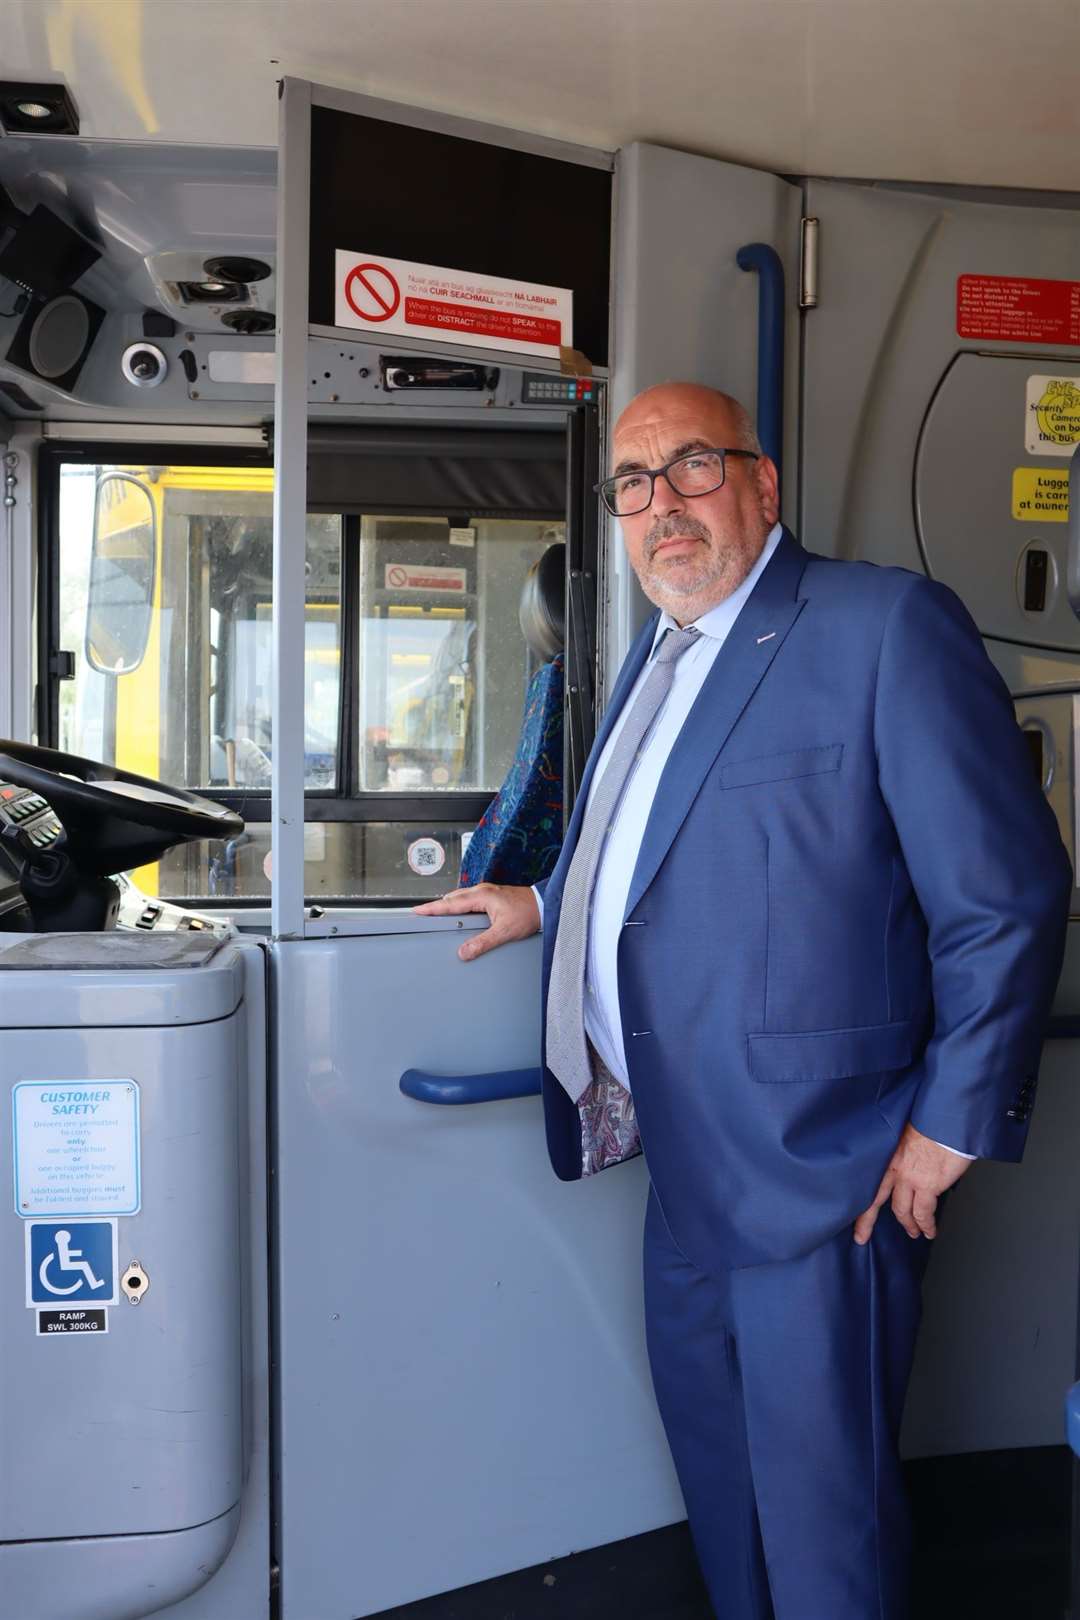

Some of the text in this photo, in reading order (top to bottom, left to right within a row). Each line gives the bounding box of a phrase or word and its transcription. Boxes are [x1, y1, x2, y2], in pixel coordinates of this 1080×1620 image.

[430, 287, 448, 296] CUIR
[450, 290, 495, 304] SEACHMALL
[408, 301, 429, 312] When
[443, 306, 456, 316] bus
[512, 318, 536, 328] SPEAK
[408, 310, 427, 319] driver
[438, 315, 475, 326] DISTRACT
[1030, 403, 1063, 414] Security
[1039, 432, 1074, 442] this bus
[1038, 477, 1069, 488] Lugga
[1035, 490, 1069, 500] is carr
[1020, 500, 1069, 511] at owner
[40, 1091, 110, 1103] CUSTOMER
[52, 1104, 98, 1116] SAFETY
[66, 1138, 86, 1146] only
[104, 1184, 126, 1193] must
[59, 1312, 86, 1321] RAMP
[47, 1322, 98, 1332] SWL 300KG
